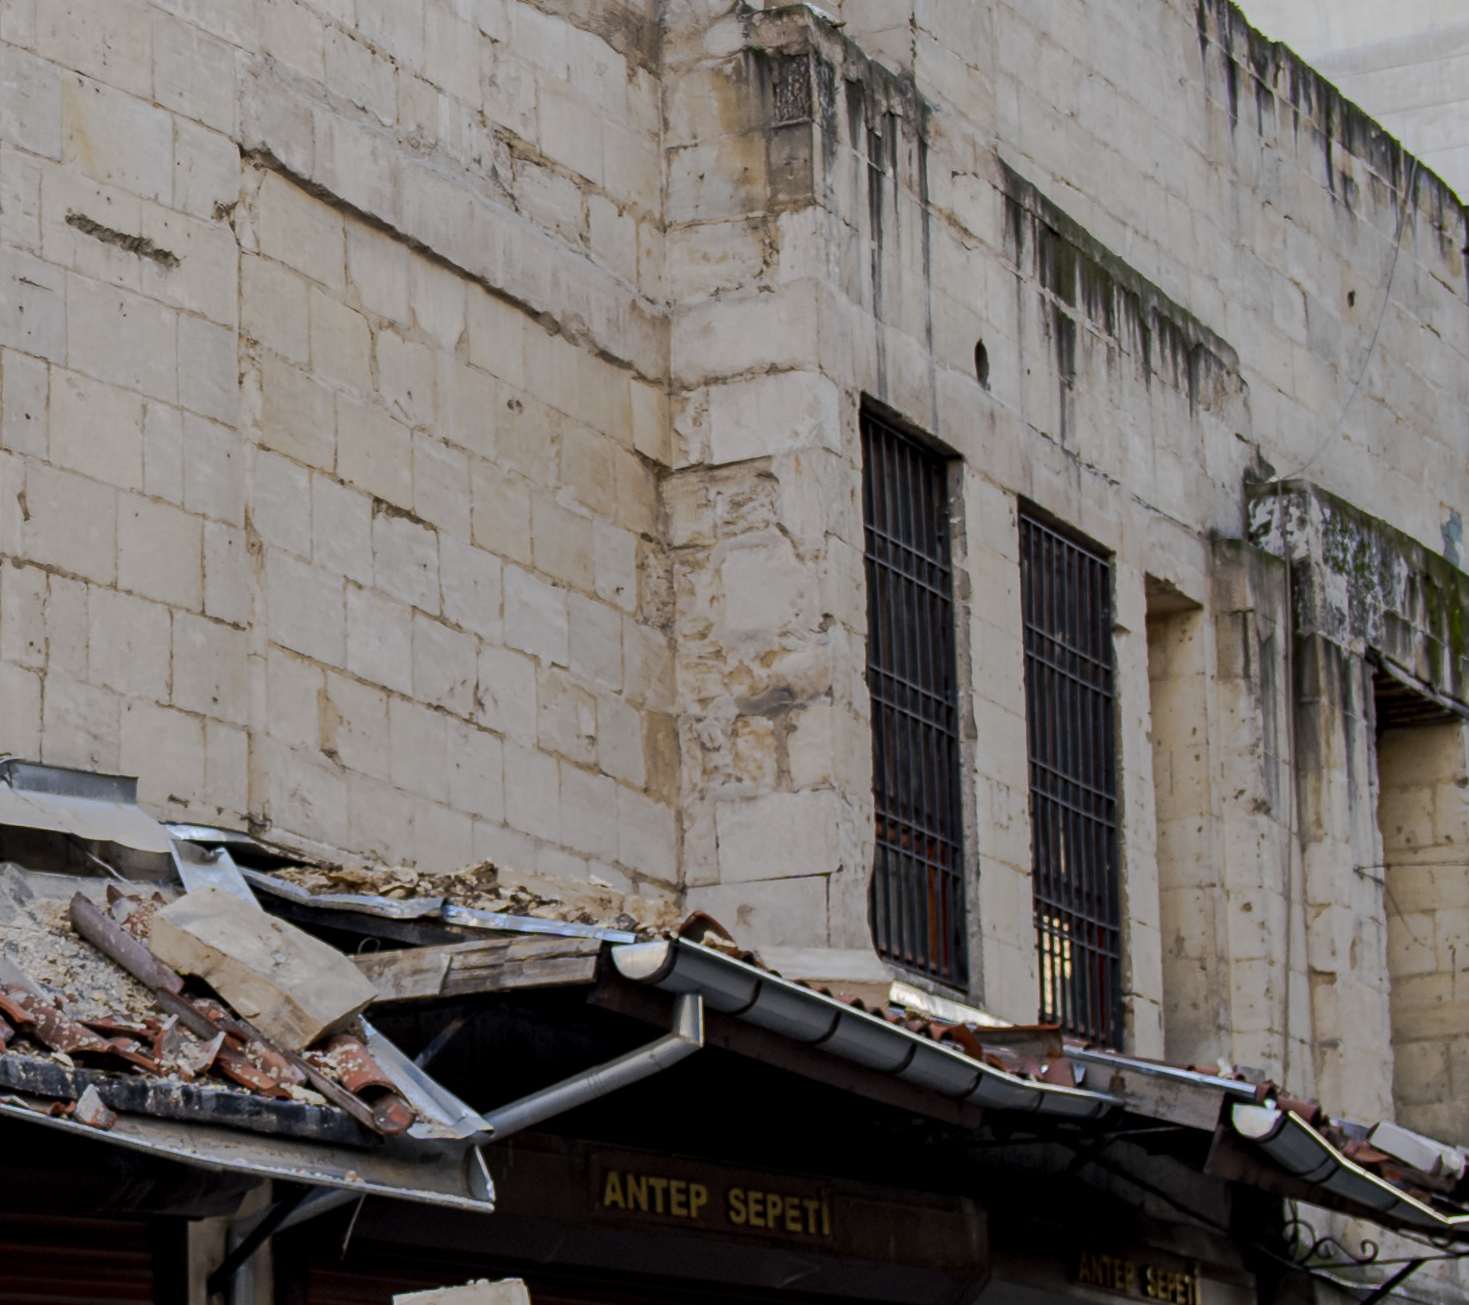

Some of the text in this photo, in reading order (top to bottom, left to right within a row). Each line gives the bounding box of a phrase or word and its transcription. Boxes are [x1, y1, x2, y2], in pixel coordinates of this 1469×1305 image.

[603, 1170, 832, 1237] ANTEP SEPETİ
[1078, 1250, 1136, 1293] ANTEP
